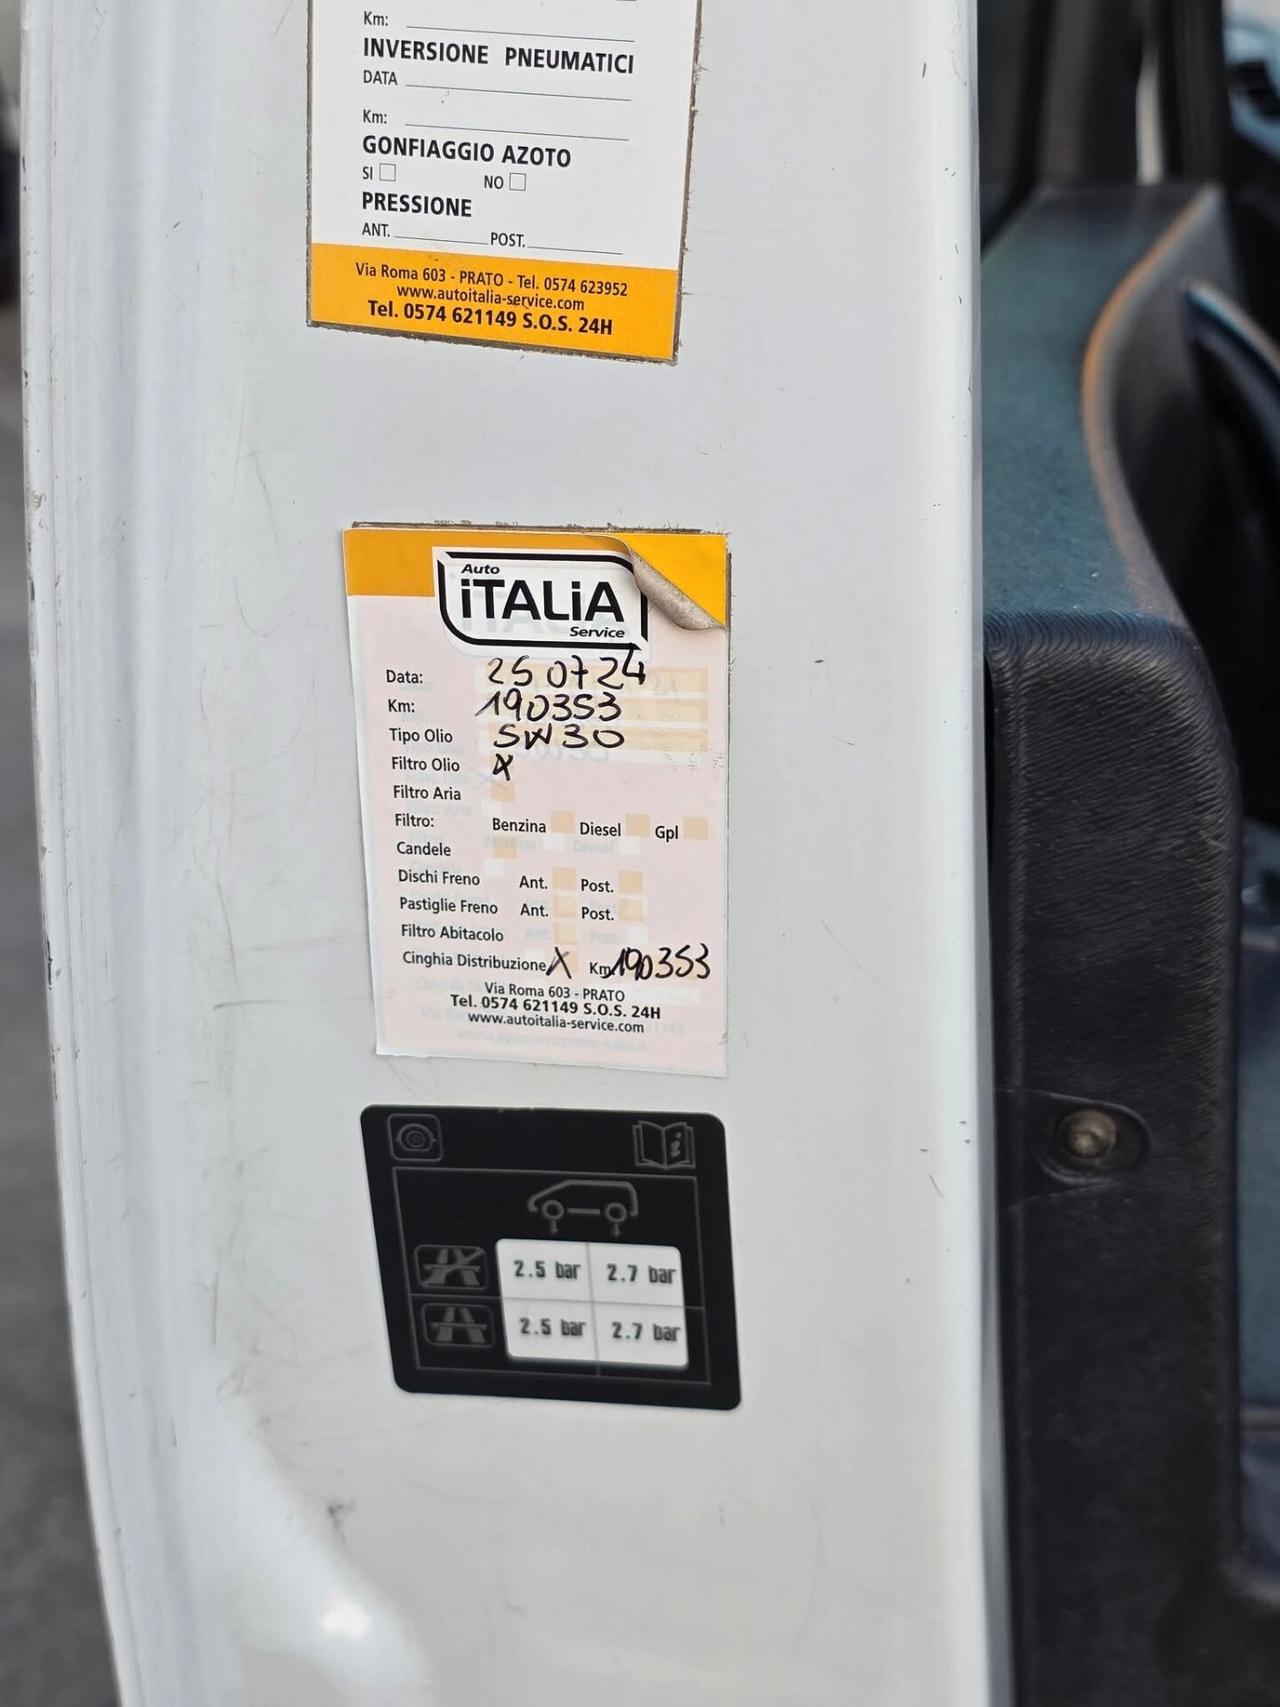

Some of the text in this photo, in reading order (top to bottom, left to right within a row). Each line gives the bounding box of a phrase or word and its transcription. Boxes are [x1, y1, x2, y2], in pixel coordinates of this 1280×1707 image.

[363, 11, 389, 27] Km:
[363, 37, 634, 74] INVERSIONE PNEUMATICI
[362, 70, 398, 86] DATA
[362, 109, 388, 125] Km:
[362, 134, 572, 168] GONFIAGGIO AZOTO
[362, 166, 504, 190] SI NO
[362, 191, 472, 218] PRESSIONE
[362, 222, 526, 248] ANT. POST.
[355, 261, 377, 277] Via
[380, 264, 418, 281] Roma
[422, 267, 446, 283] 603
[459, 269, 504, 287] PRATO
[517, 273, 539, 290] Tel.
[544, 276, 577, 293] 0574
[580, 279, 628, 297] 623952
[397, 284, 585, 312] www.autoitalia-service.com
[368, 299, 613, 336] Tel. 0574 621149 S.O.S. 24H
[461, 563, 500, 575] Auto
[569, 626, 625, 639] Service
[386, 669, 424, 684] Data:
[388, 699, 415, 714] Km:
[389, 727, 453, 745] Tipo Olio
[391, 756, 460, 773] Filtro Olio
[393, 784, 461, 801] Filtro Aria
[395, 814, 679, 840] Filtro: Benzina Diesel Gpl
[396, 842, 451, 856] Candele
[398, 869, 614, 893] Dischi Freno Ant. Post.
[400, 897, 615, 921] Pastiglie Freno Ant. Post.
[401, 924, 435, 939] Filtro
[440, 925, 504, 942] Abitacolo
[402, 951, 546, 972] Cinghia Distribuzione
[485, 981, 505, 995] Via
[508, 983, 545, 997] Roma
[548, 985, 571, 999] 603
[583, 988, 625, 1002] PRATO
[450, 993, 661, 1020] Tel. 0574 621149 S.O.S. 24H
[468, 1011, 645, 1034] www.autoitalia-service.com
[514, 1260, 581, 1280] 2.5 bar
[607, 1264, 676, 1284] 2.7 bar
[519, 1318, 586, 1338] 2.5 bar
[611, 1321, 680, 1342] 2.7 bar
